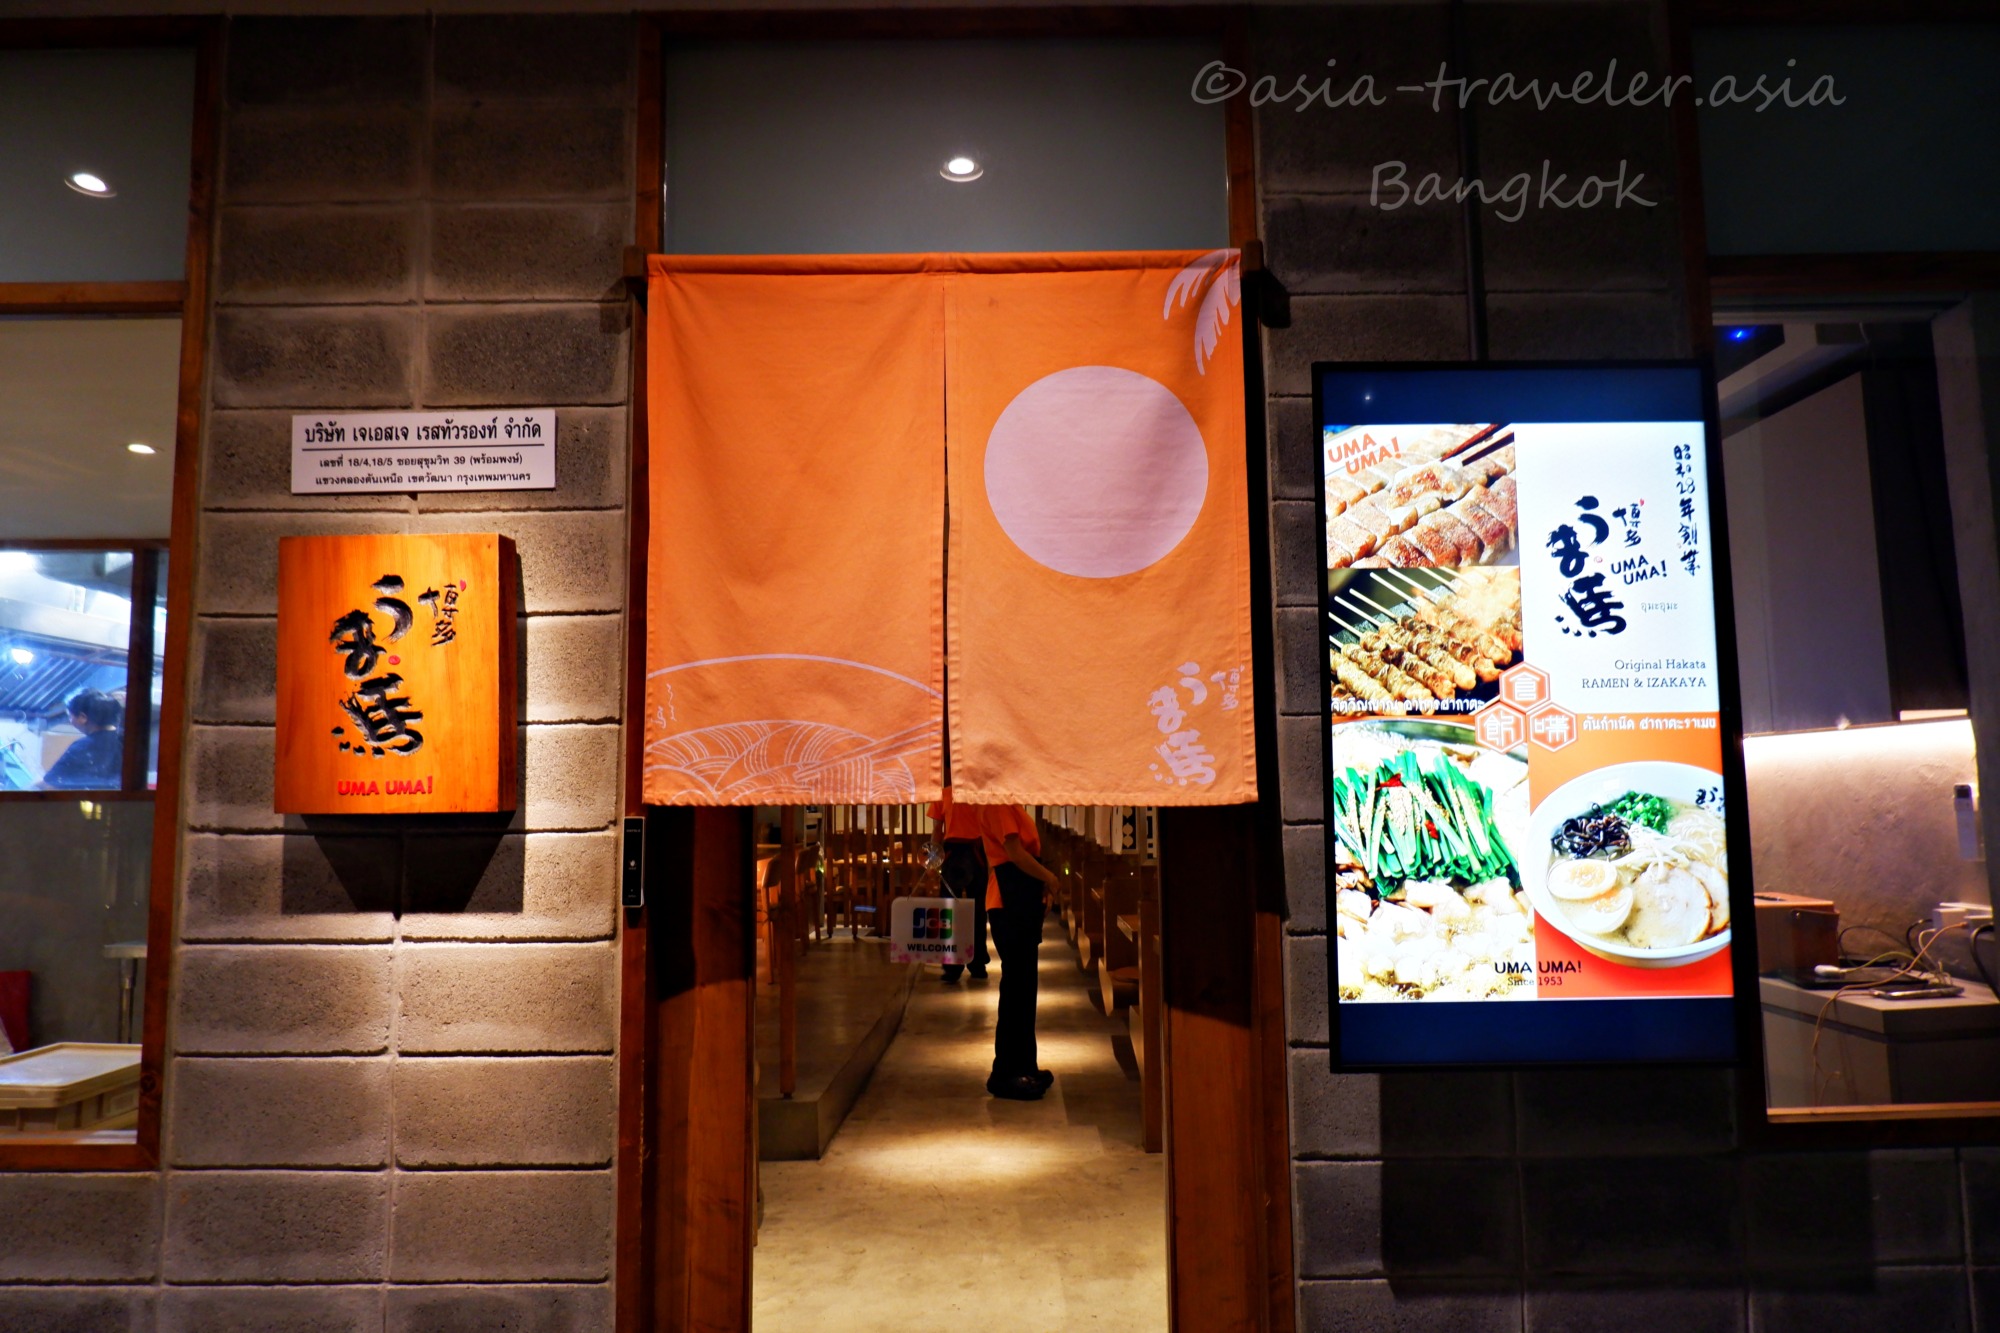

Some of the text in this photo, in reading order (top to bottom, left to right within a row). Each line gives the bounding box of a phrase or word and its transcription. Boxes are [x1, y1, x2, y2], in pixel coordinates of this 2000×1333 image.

[305, 422, 345, 443] บริษัท
[353, 425, 409, 442] เจเอสเจ
[504, 416, 541, 439] จำกัด
[1327, 433, 1377, 463] UMA
[1345, 436, 1402, 475] UMA!
[454, 456, 466, 465] 39
[456, 473, 531, 486] กรุงเทพมหานคร
[1611, 554, 1649, 575] UMA
[1623, 559, 1668, 585] UMA!
[1614, 658, 1706, 673] Original Hakata
[1581, 676, 1707, 689] RAMEN & IZAKAYA
[337, 776, 433, 796] UMA UMA!
[907, 943, 958, 953] WELCOME
[1494, 960, 1582, 974] UMA UMA!
[1507, 976, 1563, 986] Since 1953
